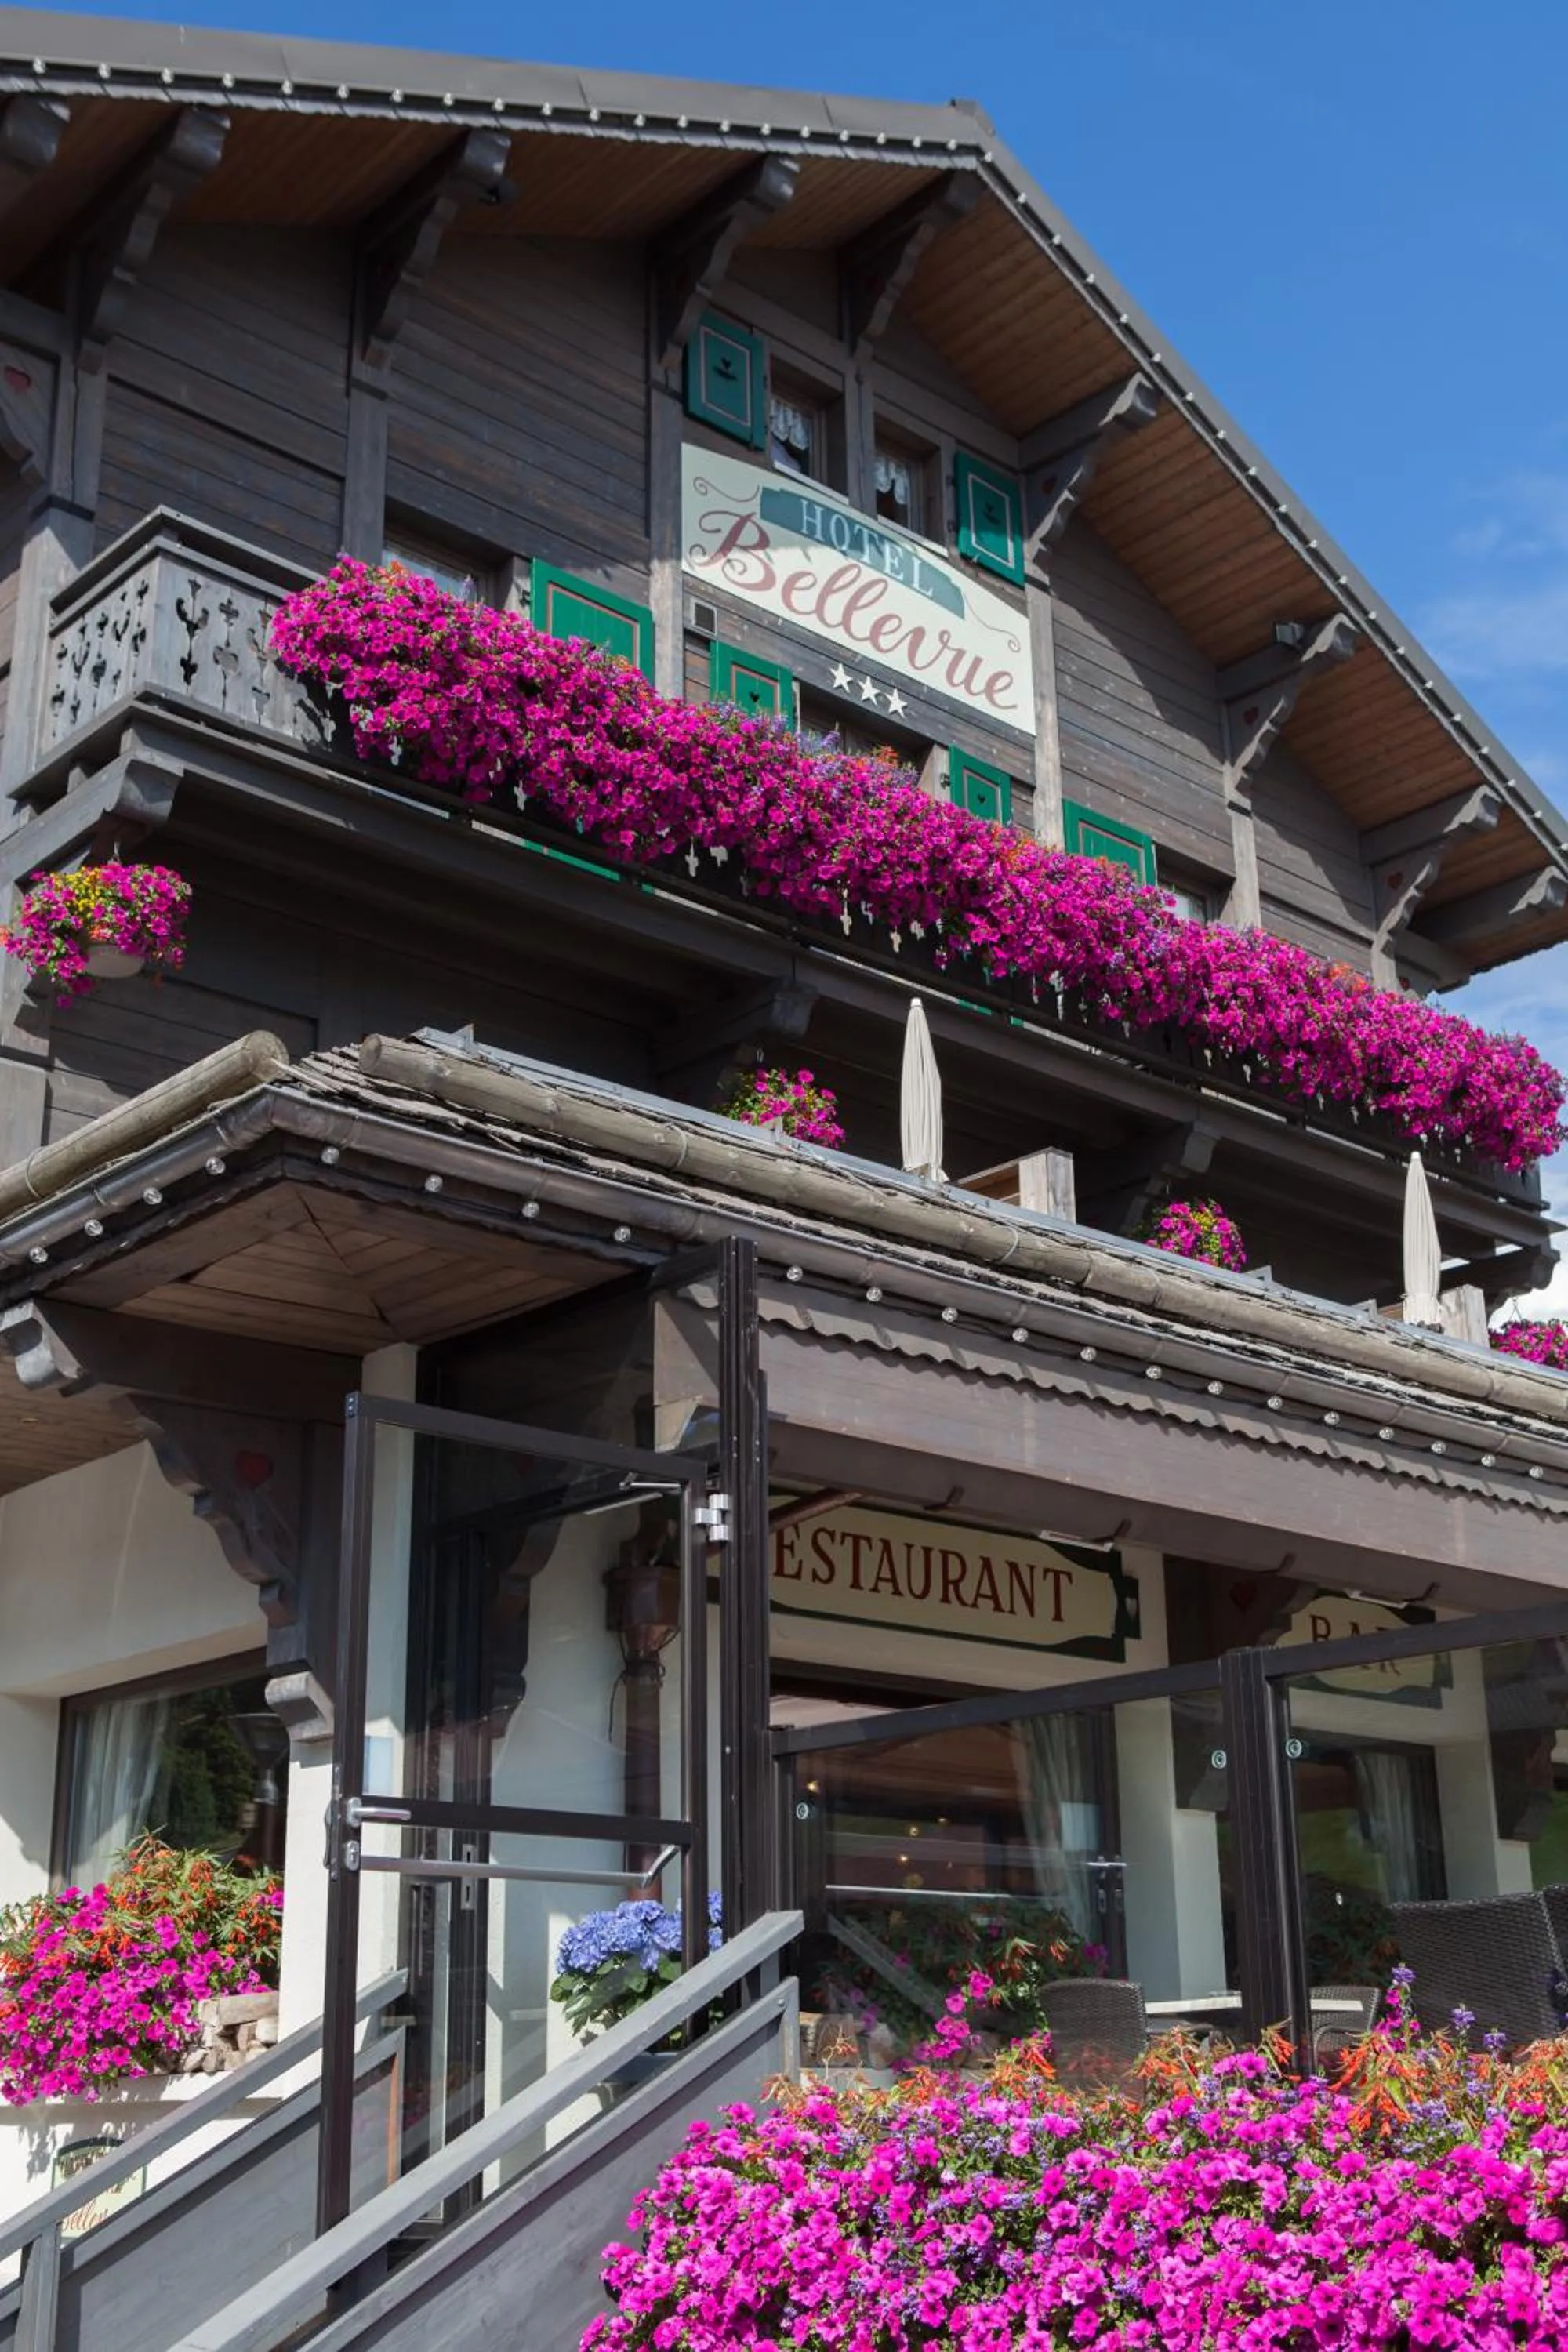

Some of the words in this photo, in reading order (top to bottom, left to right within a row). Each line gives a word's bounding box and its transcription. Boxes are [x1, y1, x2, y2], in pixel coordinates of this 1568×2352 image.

[800, 499, 935, 597] HOTEL
[689, 510, 1018, 710] Bellevue
[773, 1521, 1073, 1622] ESTAURANT
